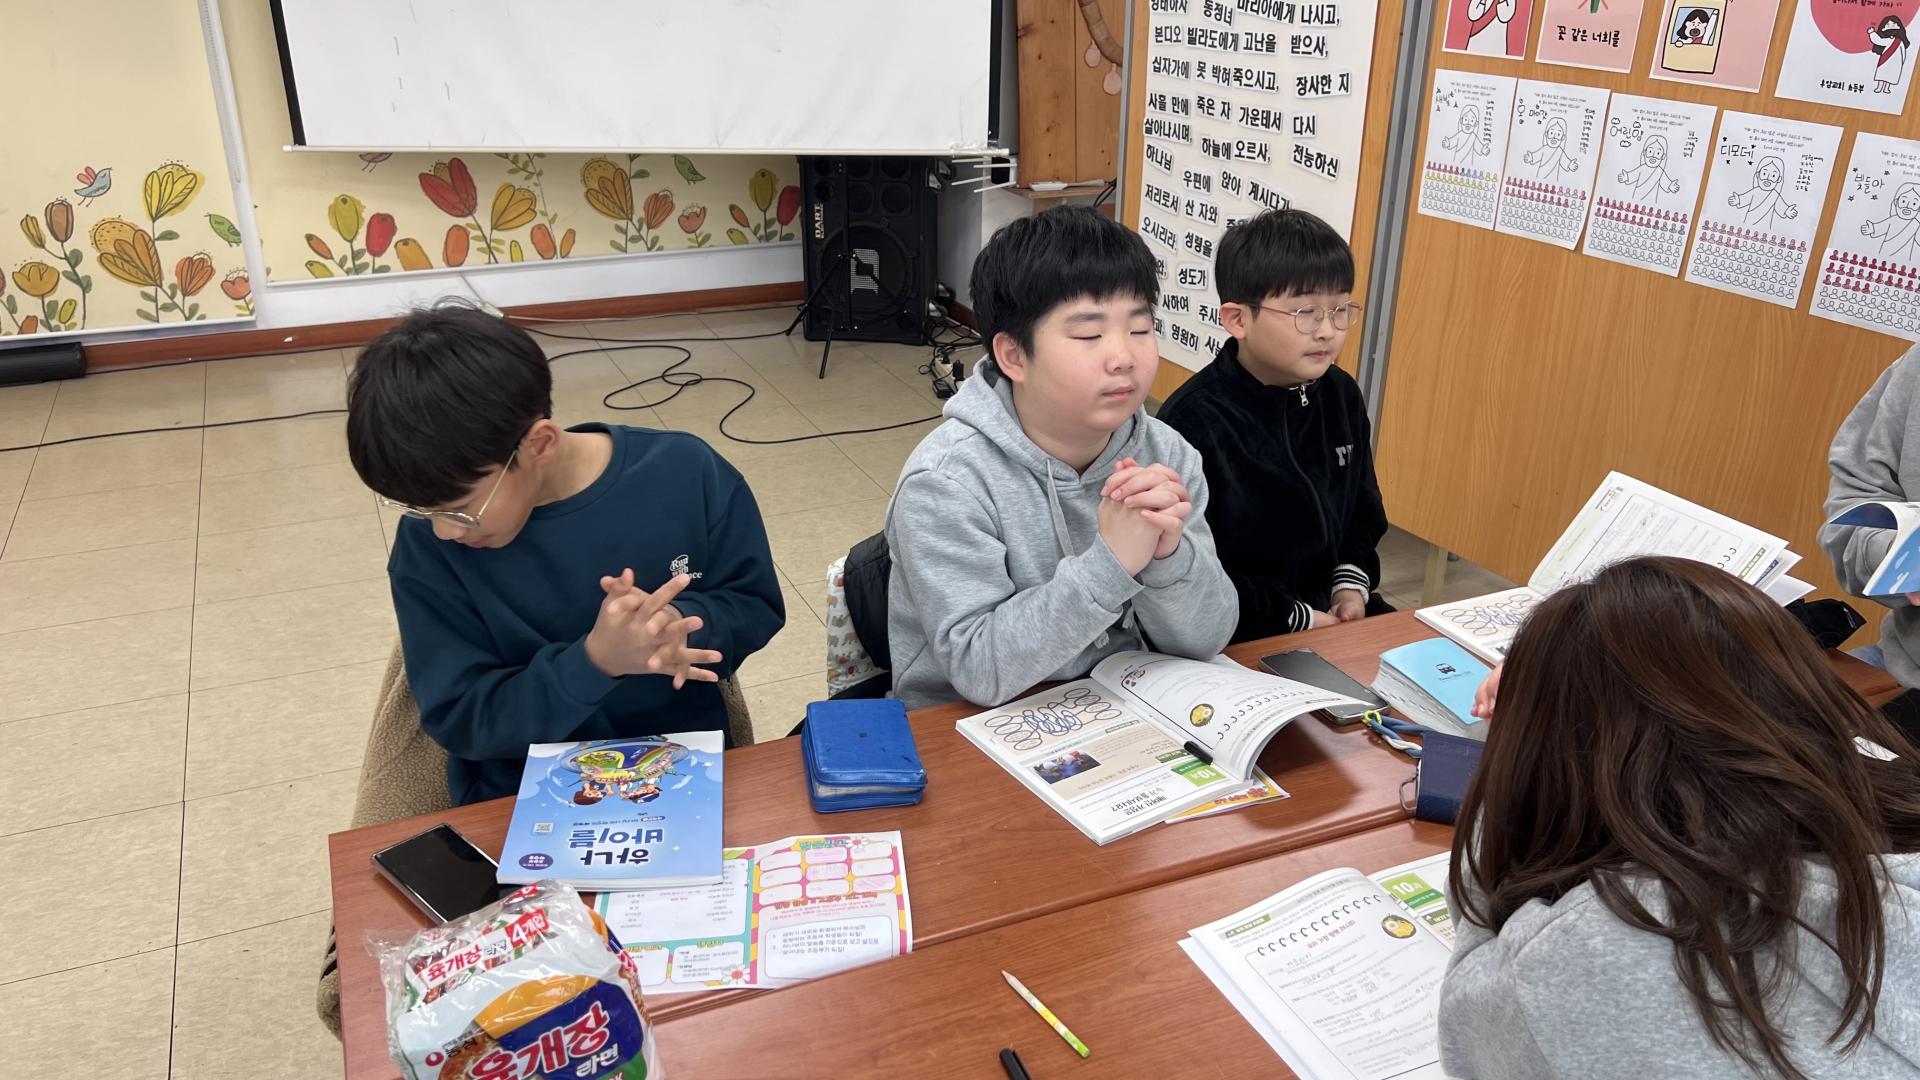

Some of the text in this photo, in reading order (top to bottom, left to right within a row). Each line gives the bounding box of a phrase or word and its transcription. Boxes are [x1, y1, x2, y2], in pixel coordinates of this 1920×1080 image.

[1300, 4, 1340, 25] 나시고,
[1154, 25, 1328, 57] 본디오 빌라도에게 고난을 받으사,
[1557, 25, 1620, 48] 꽃 같은 너희를
[1152, 56, 1350, 96] 십자가에 못 박혀 죽으시고, 장사한 지
[1148, 93, 1166, 111] 사흘
[1172, 96, 1189, 115] 만에
[1196, 96, 1215, 116] 죽은
[1220, 101, 1231, 120] 자
[1293, 115, 1316, 135] 다시
[1144, 117, 1339, 178] 살아나시며, 하늘에 오르사, 전능하신
[1720, 144, 1754, 159] 디모데
[1145, 144, 1291, 210] 하나님 우편에 앉아 계시다가
[1144, 183, 1179, 213] 저리로서
[1185, 199, 1195, 216] 산
[1199, 202, 1218, 224] 자와
[1142, 216, 1213, 257] 오시리라. 성령을
[1179, 267, 1206, 286] 성도가
[1162, 294, 1189, 312] 사하여
[1171, 323, 1199, 351] 영원히
[672, 558, 689, 569] Run
[569, 828, 663, 848] 바이블
[580, 848, 649, 865] 하나
[427, 945, 483, 982] 육개장
[511, 914, 546, 945] 4개입
[471, 1000, 610, 1080] 육개장
[576, 1043, 619, 1077] 라면
